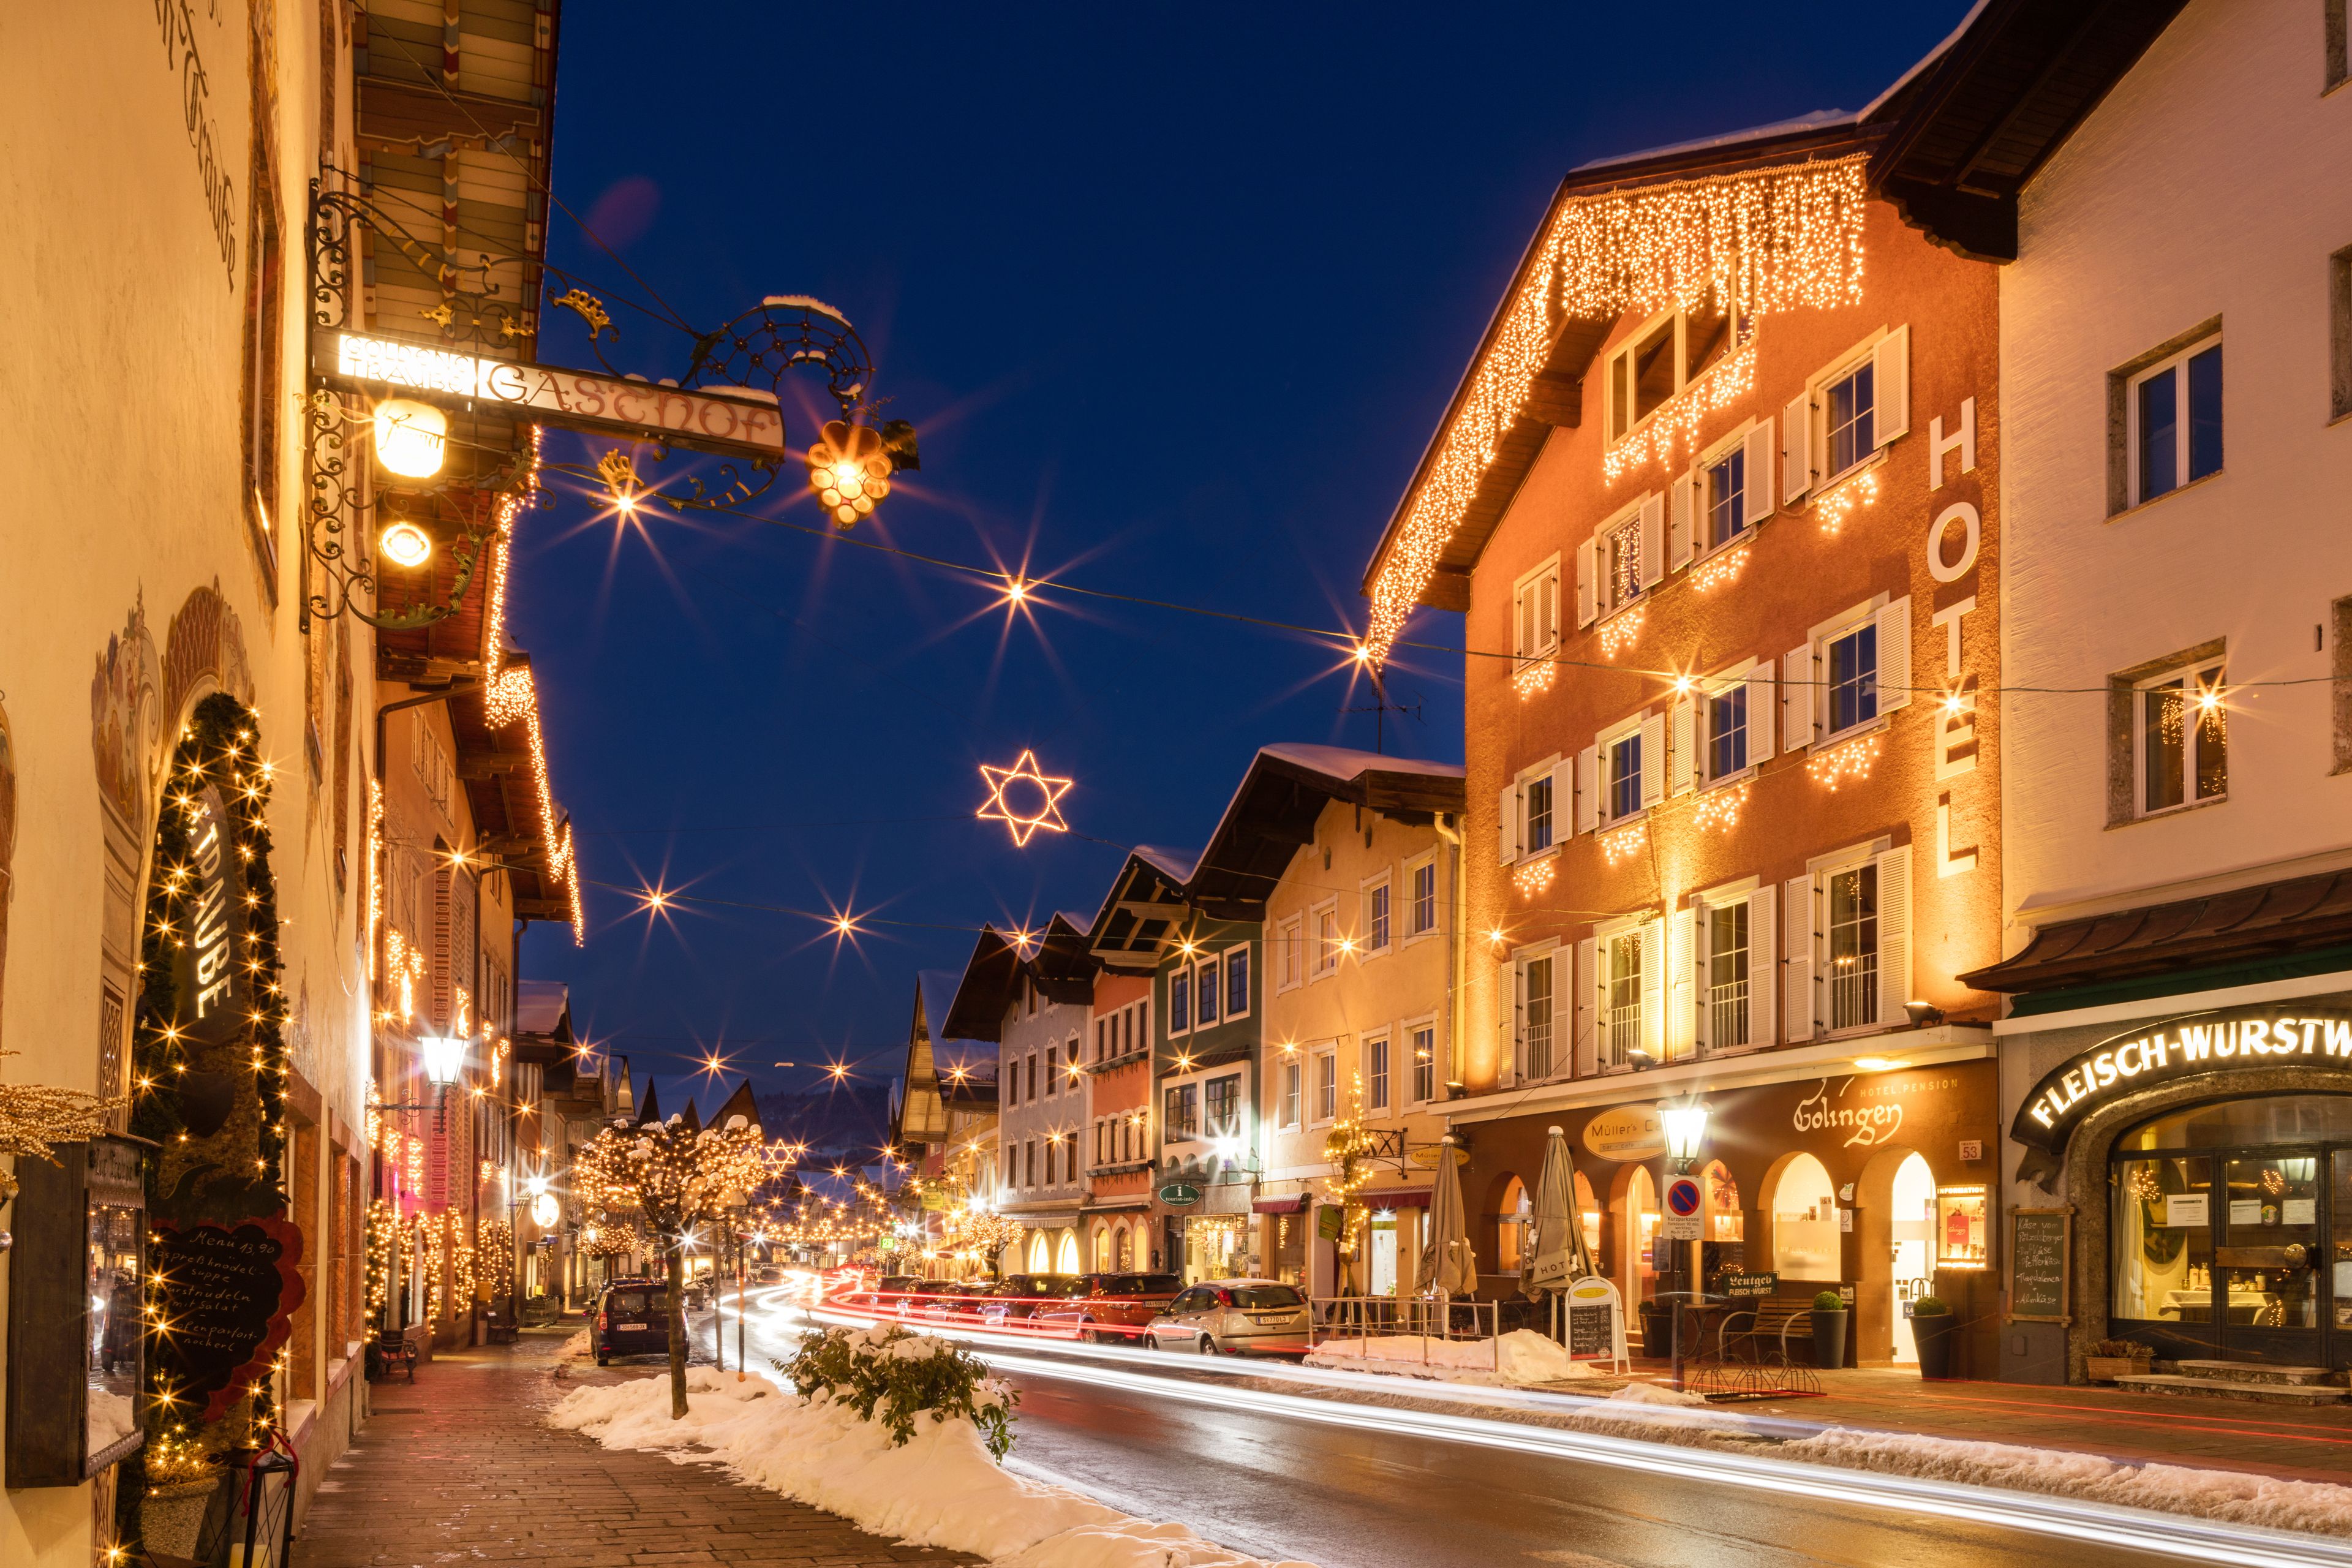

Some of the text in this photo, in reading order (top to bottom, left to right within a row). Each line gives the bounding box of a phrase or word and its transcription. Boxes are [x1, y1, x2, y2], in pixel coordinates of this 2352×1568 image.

[347, 356, 464, 393] TRAUBE
[487, 363, 779, 442] GASTHOF
[1927, 396, 1982, 878] HOTEL
[191, 821, 232, 1019] TRAUBE
[1591, 1123, 1637, 1137] Müller's
[1962, 1146, 1978, 1158] 53
[189, 1230, 276, 1256] Menü 13,90
[191, 1267, 231, 1283] suppe
[1729, 1275, 1772, 1287] Leutgeb
[165, 1284, 251, 1302] urstnudeln
[172, 1298, 239, 1313] mit Salat
[183, 1337, 237, 1352] nockerl
